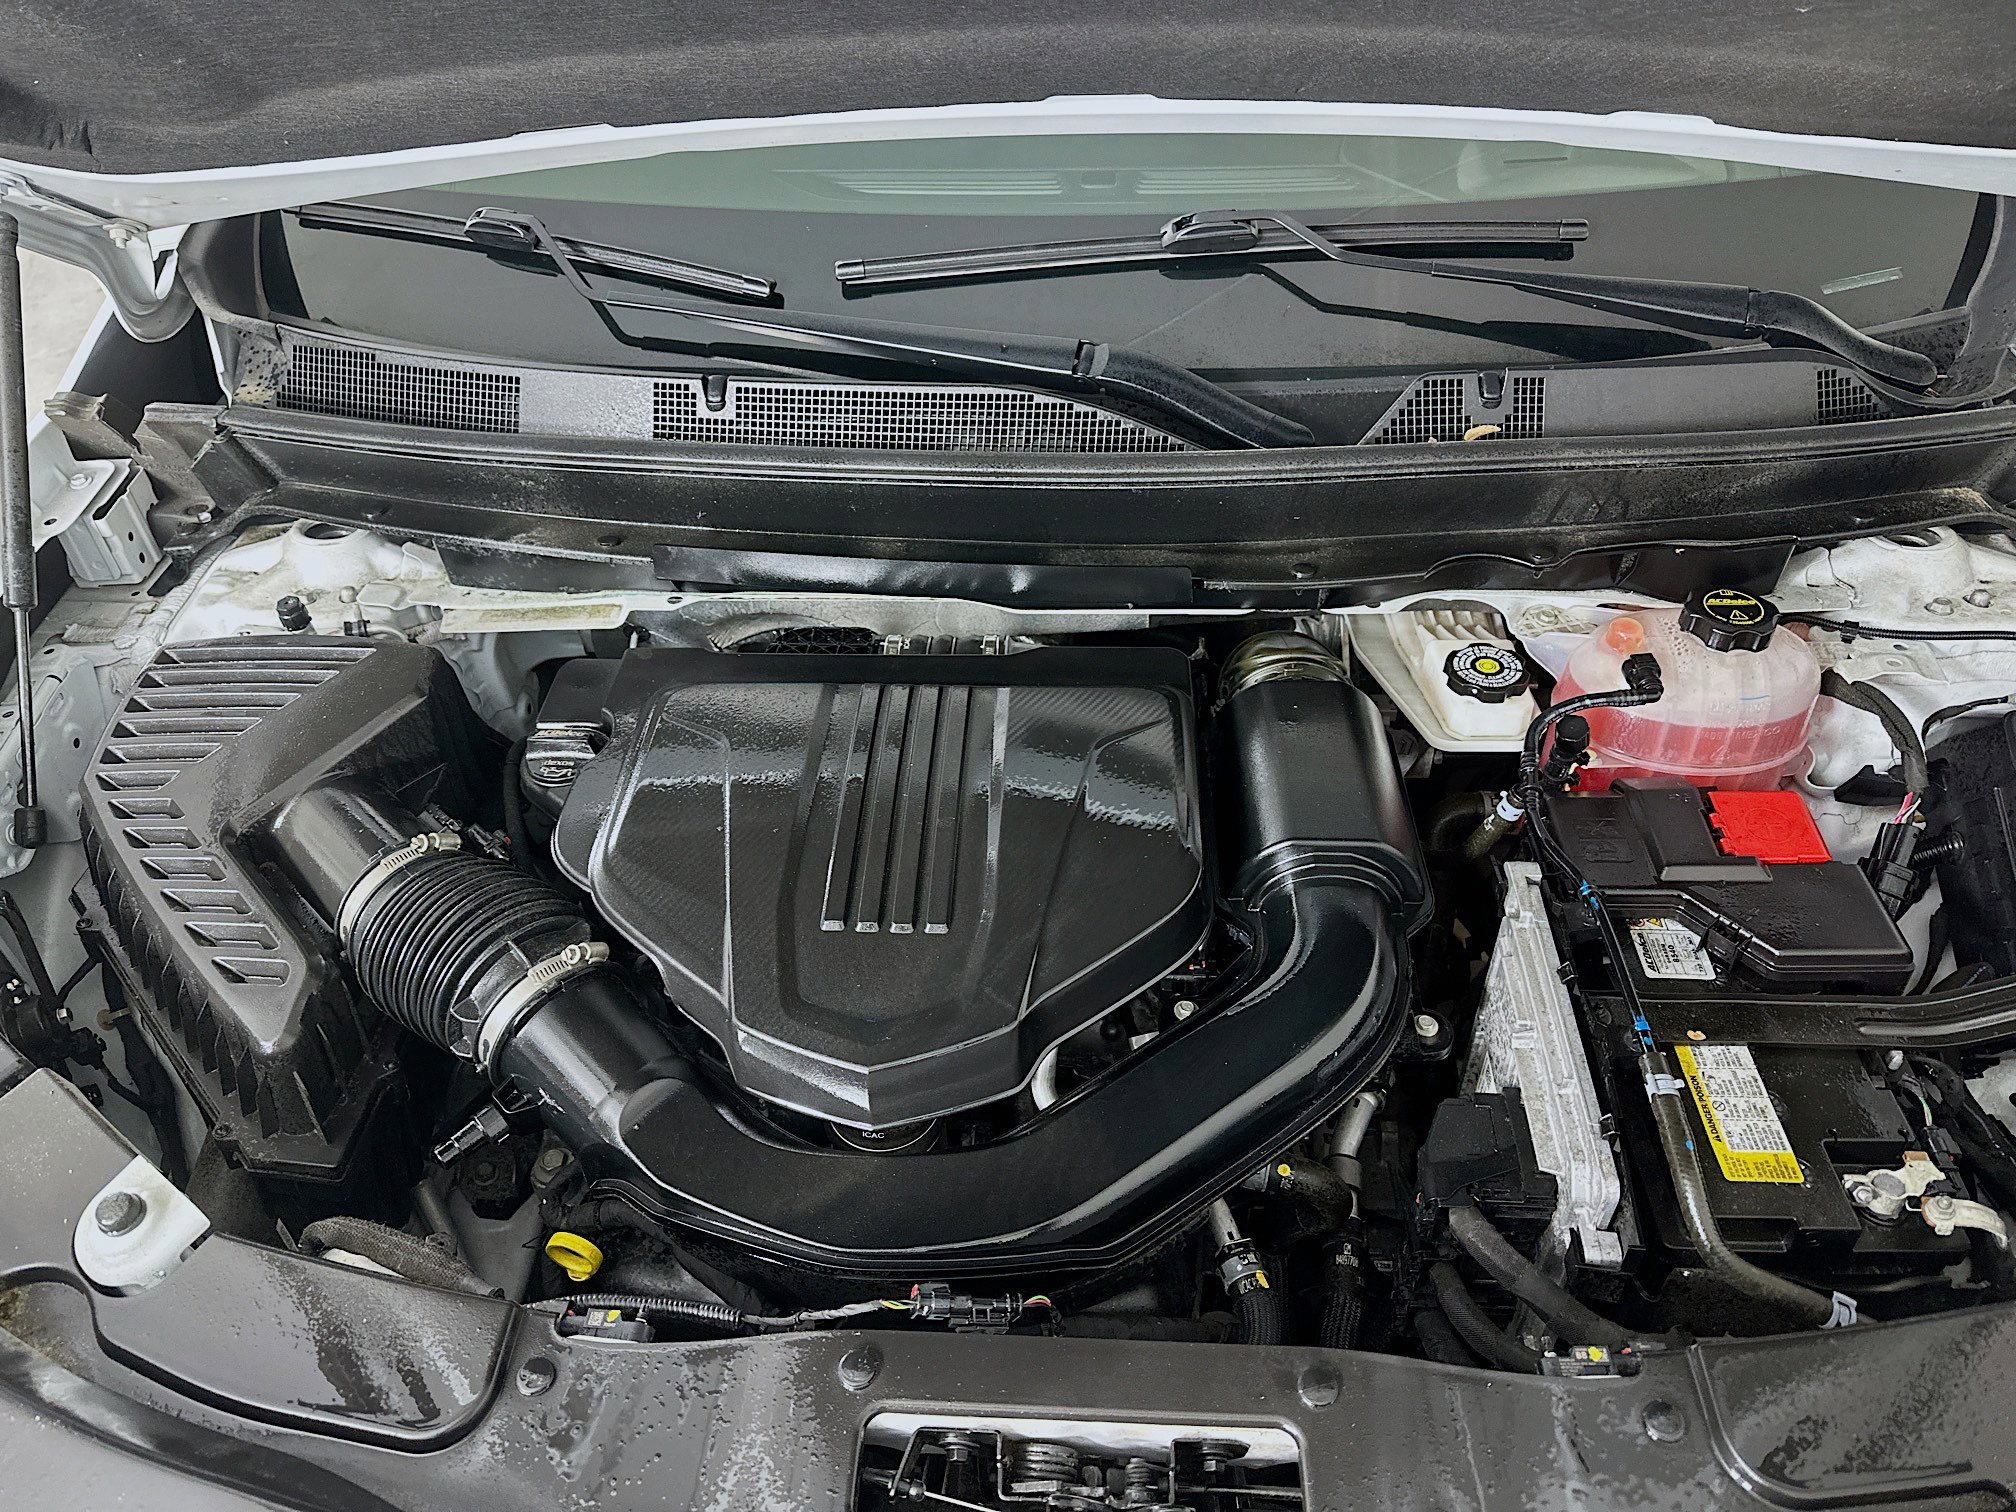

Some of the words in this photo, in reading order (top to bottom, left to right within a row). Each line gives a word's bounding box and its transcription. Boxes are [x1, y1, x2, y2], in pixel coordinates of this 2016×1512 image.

[1706, 598, 1756, 606] ACDelco
[1637, 932, 1657, 973] ACDelco
[1689, 1075, 1706, 1102] POISON
[1701, 1104, 1718, 1136] DANGER
[862, 1131, 885, 1139] ICAC
